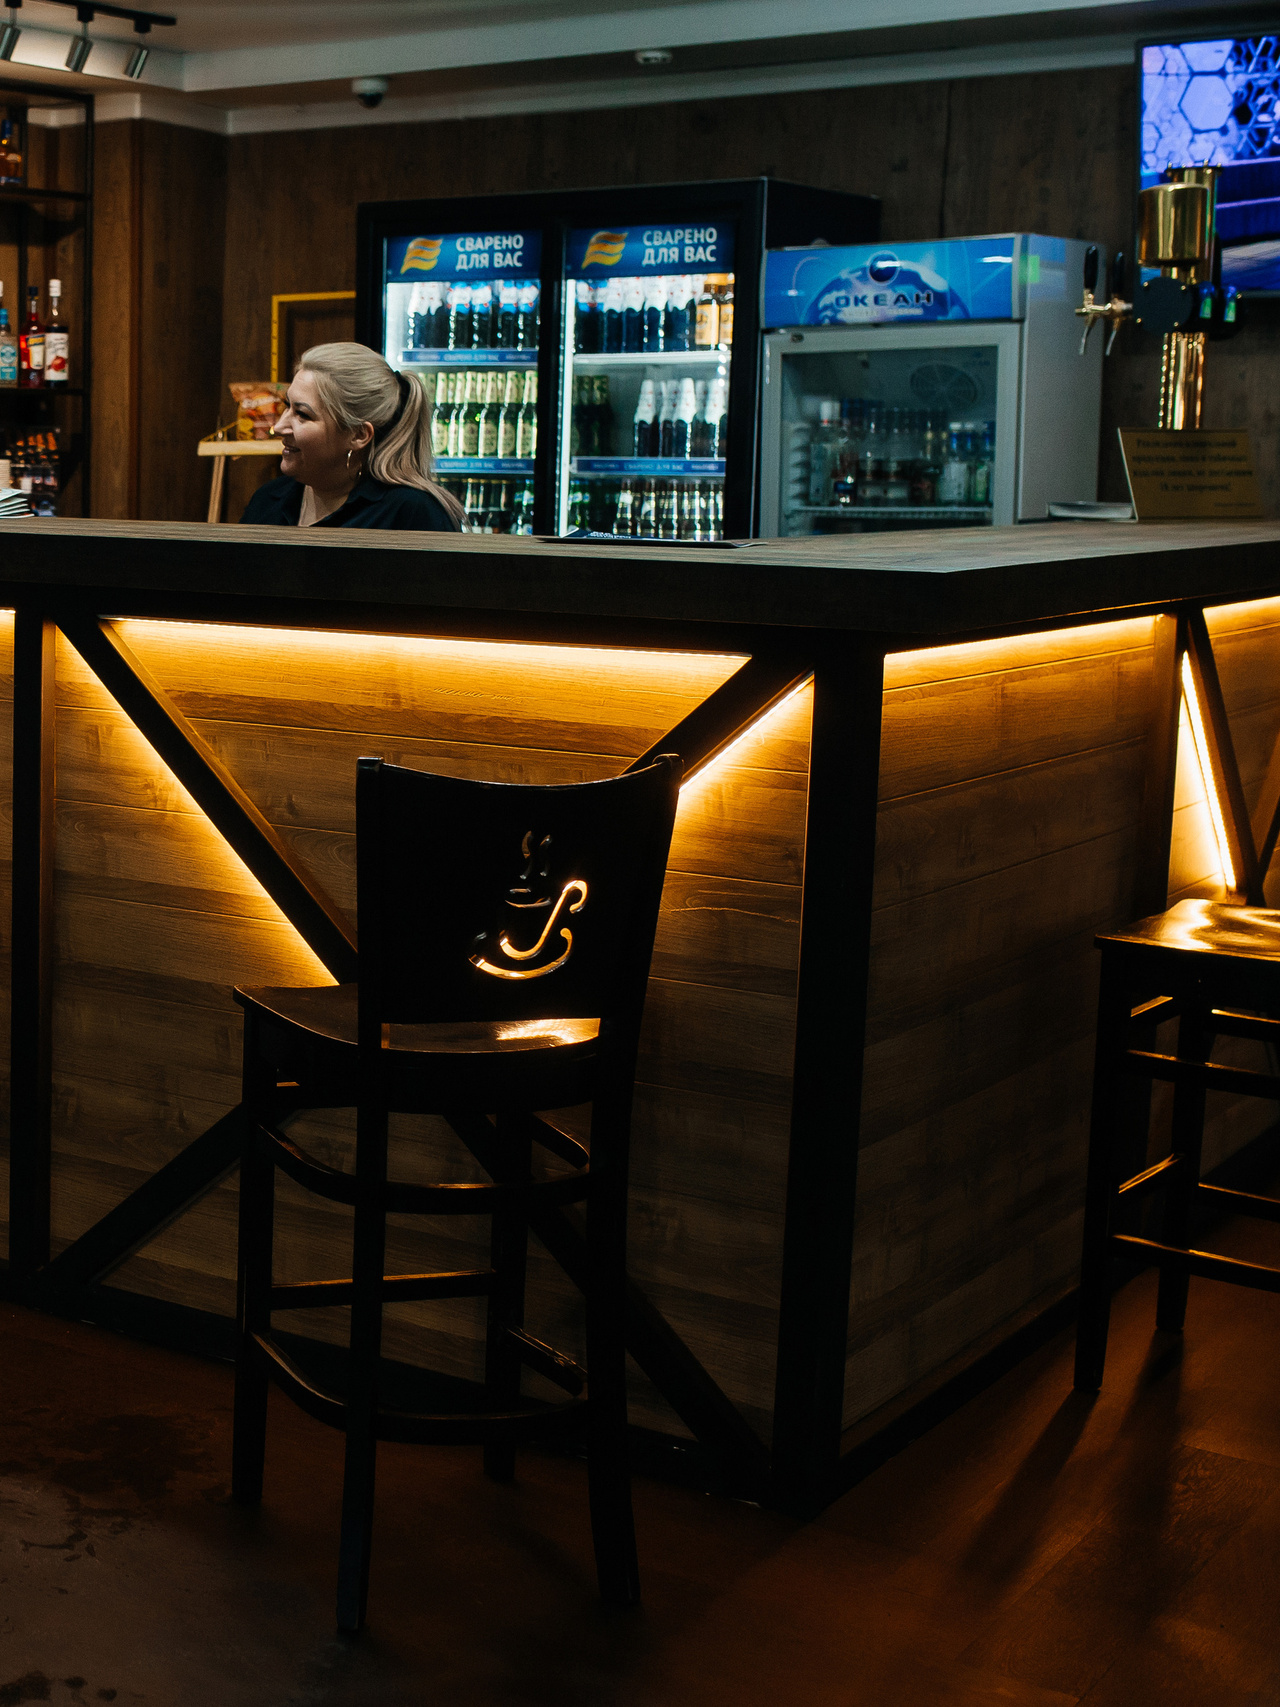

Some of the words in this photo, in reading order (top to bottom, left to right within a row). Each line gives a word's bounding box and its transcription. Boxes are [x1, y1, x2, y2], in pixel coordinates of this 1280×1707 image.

[456, 235, 524, 252] СВАРЕНО
[642, 228, 718, 246] СВАРЕНО
[455, 253, 489, 272] ДЛЯ
[493, 251, 523, 268] ВАС
[642, 247, 679, 267] ДЛЯ
[684, 245, 717, 263] ВАС
[835, 291, 932, 308] ОКЕАН
